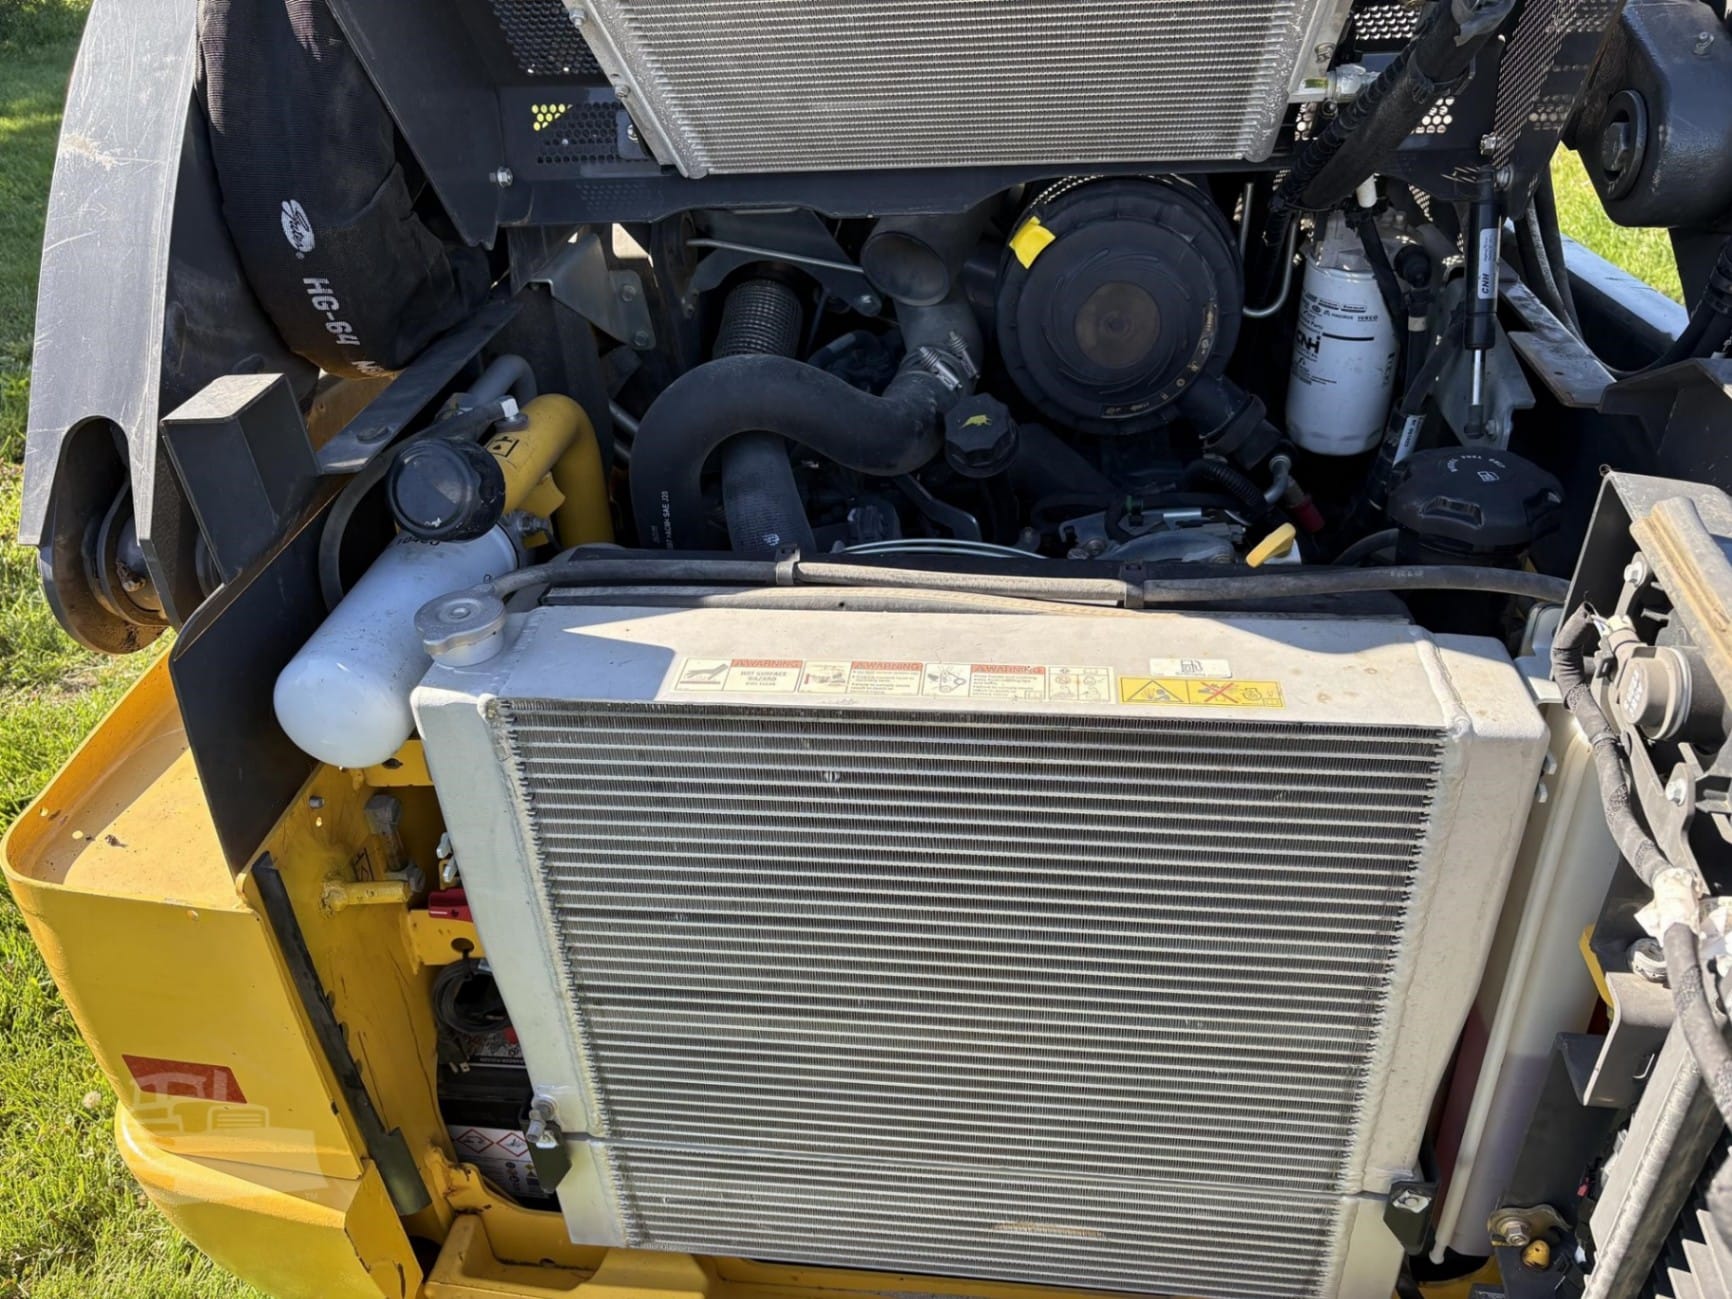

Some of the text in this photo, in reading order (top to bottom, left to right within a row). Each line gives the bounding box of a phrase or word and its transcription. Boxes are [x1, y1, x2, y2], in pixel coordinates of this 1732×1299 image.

[1481, 272, 1490, 294] CNH
[303, 277, 360, 346] HG-64
[866, 662, 921, 670] WARNING
